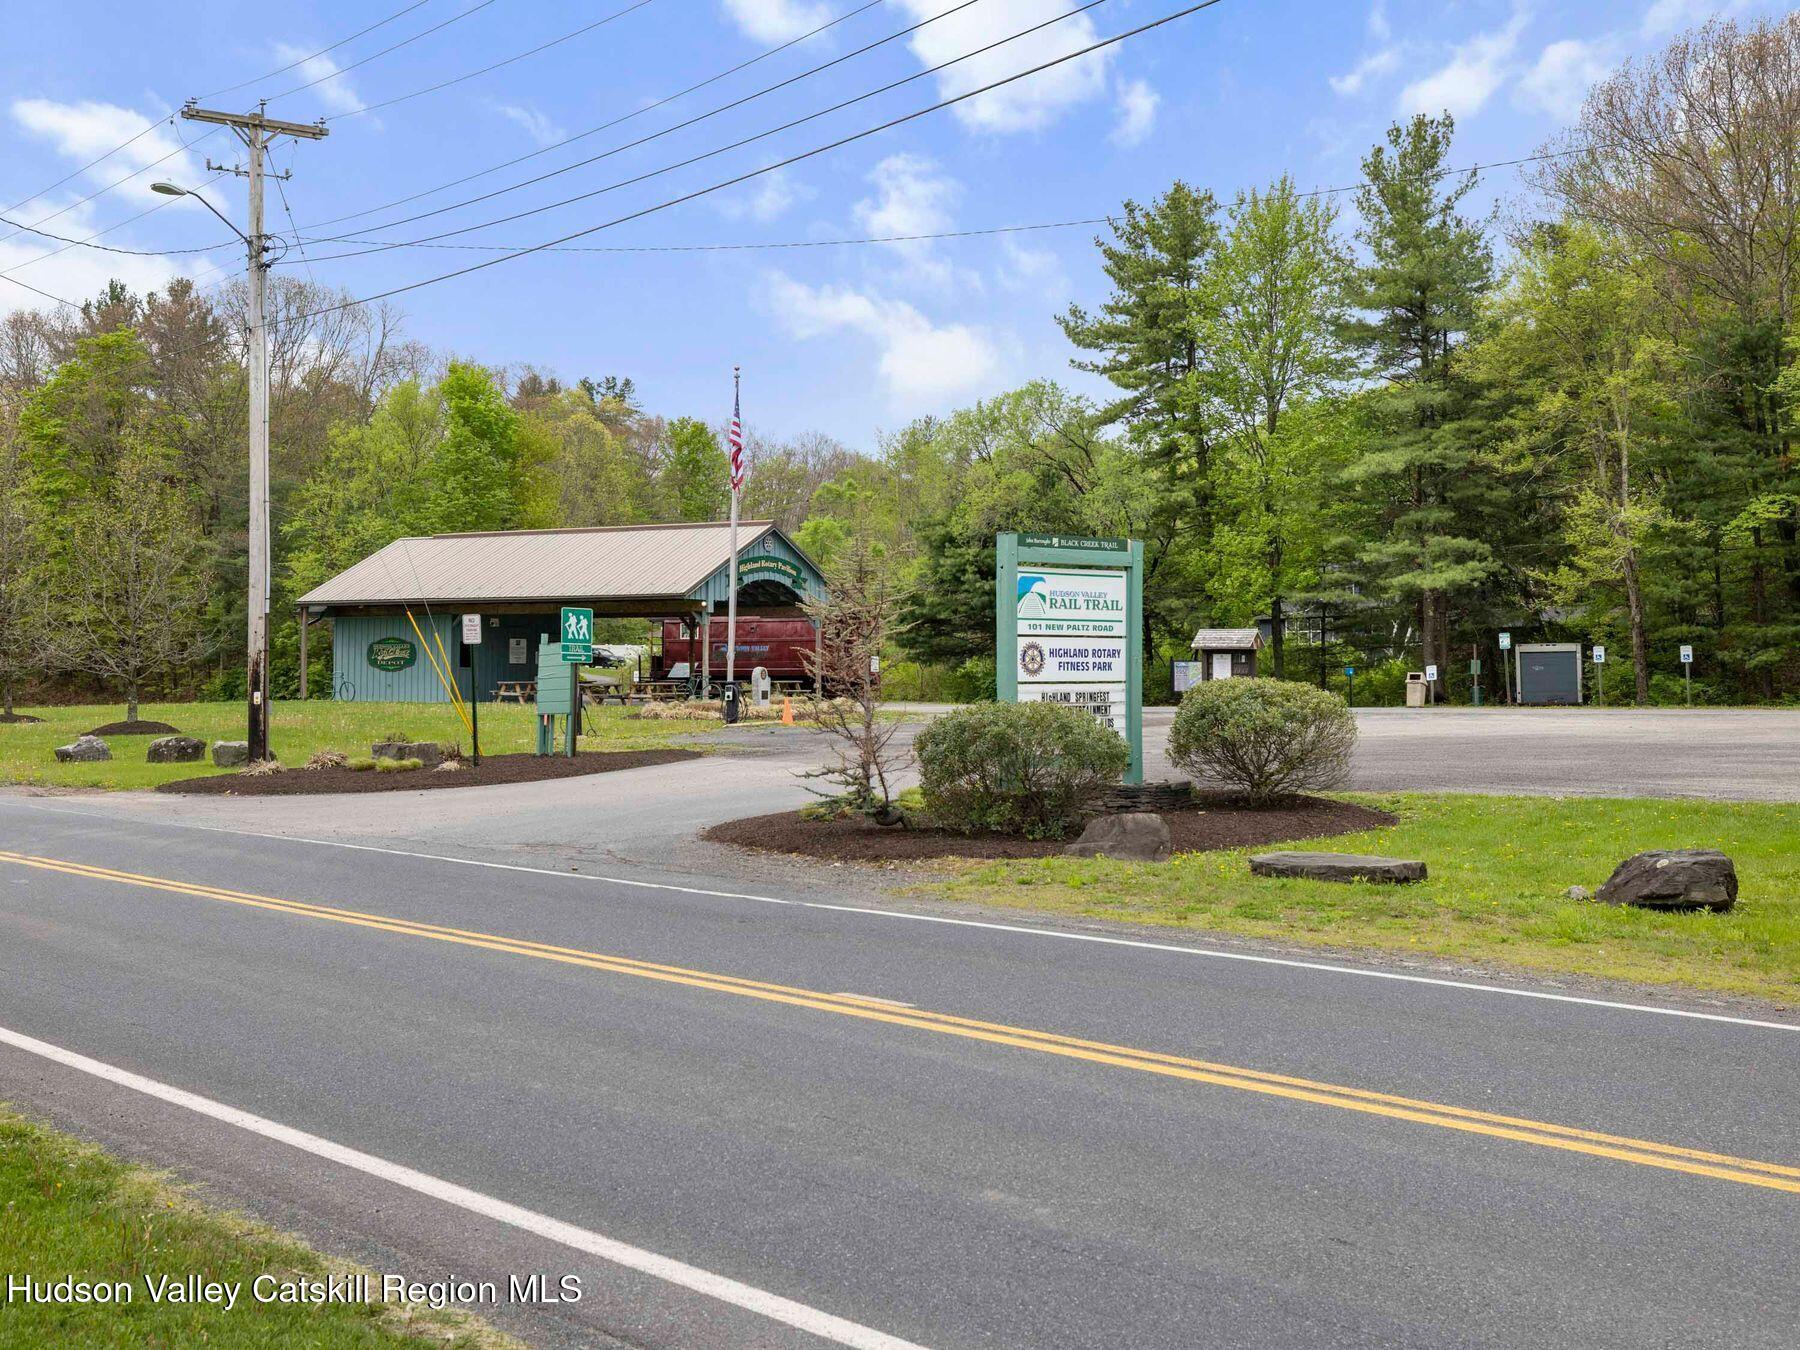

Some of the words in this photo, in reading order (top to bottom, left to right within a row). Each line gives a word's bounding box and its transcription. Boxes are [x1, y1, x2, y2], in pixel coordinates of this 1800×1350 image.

[1080, 540, 1099, 548] CREEK
[1101, 541, 1119, 549] TRAIL
[1049, 590, 1080, 598] HUDSON
[1049, 597, 1081, 610] RAIL
[1083, 599, 1123, 611] TRAIL
[1066, 624, 1090, 632] PALTZ
[1049, 648, 1089, 658] HIGHLAND
[1091, 649, 1121, 659] ROTARY
[1058, 662, 1090, 671] FITNESS
[1092, 662, 1113, 671] PARK
[1074, 692, 1110, 702] SPRINGFEST
